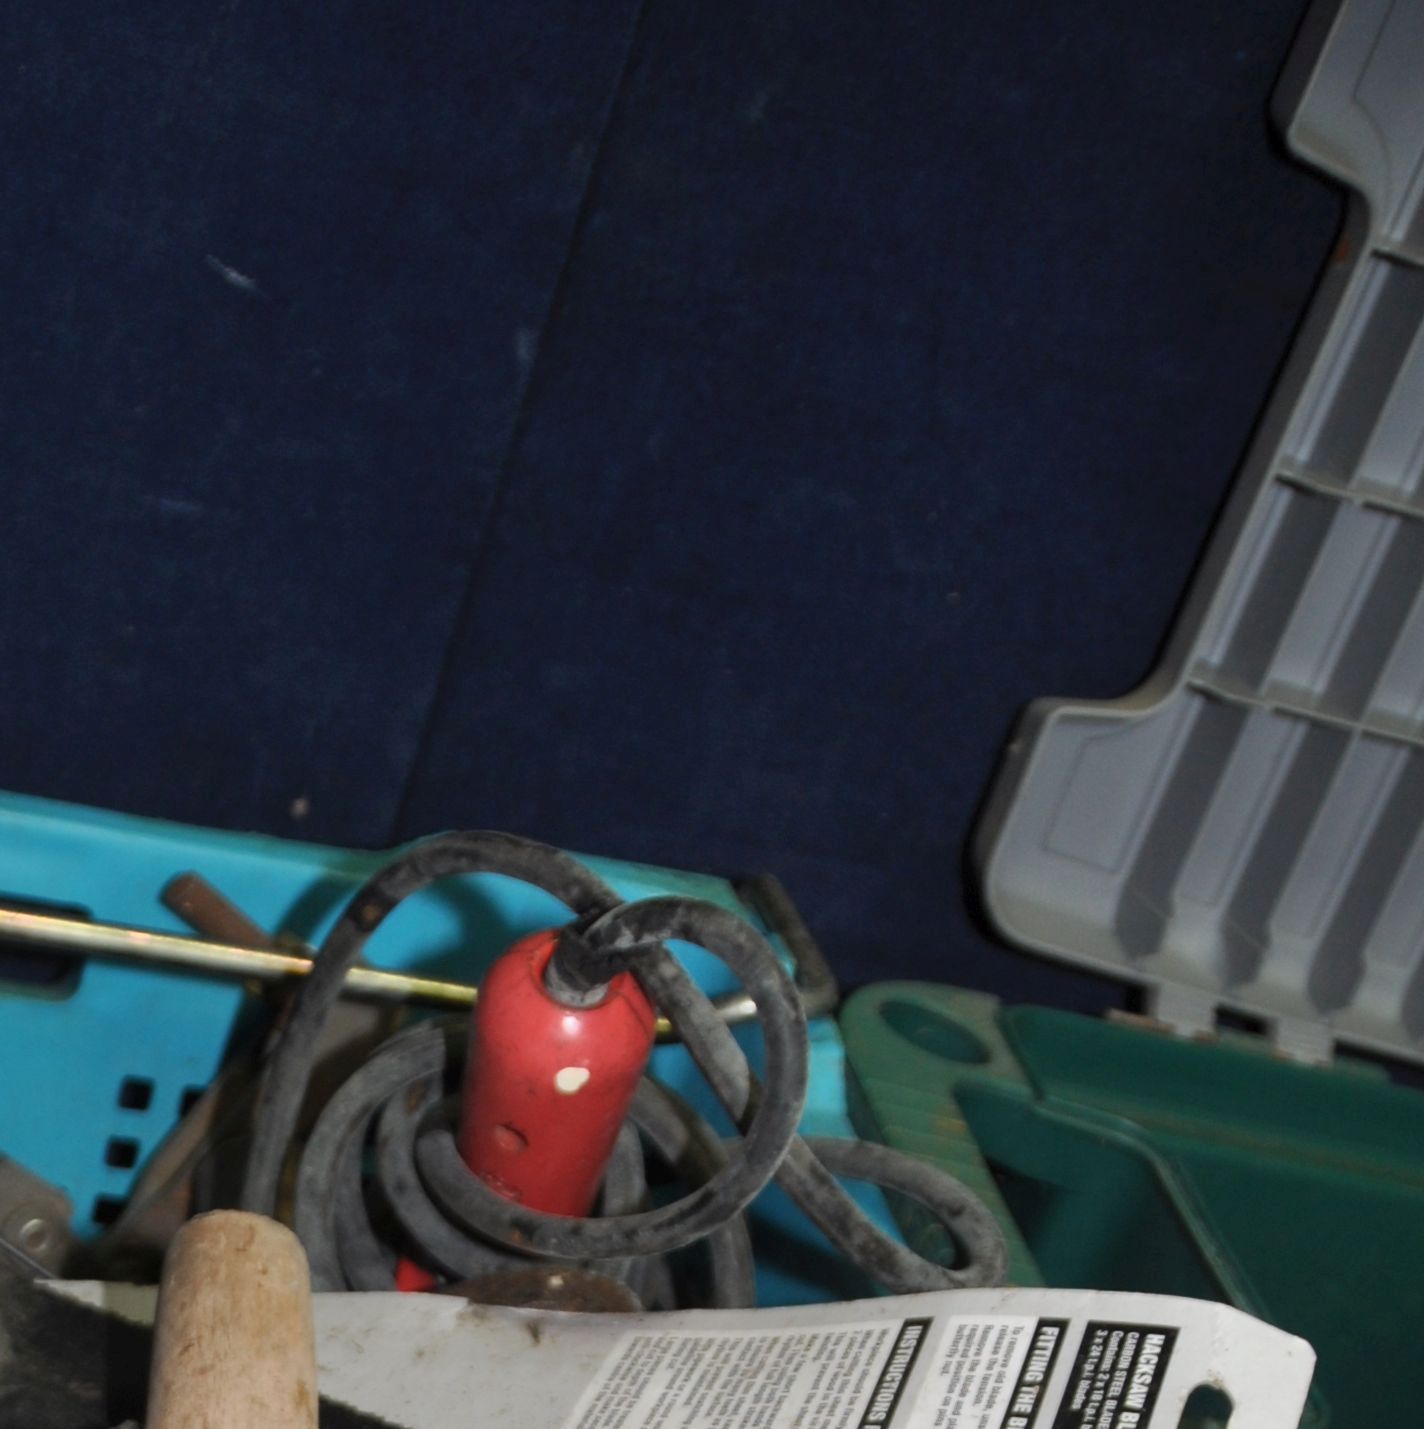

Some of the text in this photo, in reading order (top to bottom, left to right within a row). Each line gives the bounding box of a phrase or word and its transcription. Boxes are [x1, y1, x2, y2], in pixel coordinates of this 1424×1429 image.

[944, 1324, 968, 1358] butterfly
[957, 1324, 980, 1357] required
[972, 1324, 994, 1356] Remove
[989, 1325, 1010, 1355] release
[1011, 1326, 1024, 1335] To
[984, 1358, 998, 1371] the
[999, 1337, 1017, 1367] remove
[1021, 1326, 1061, 1381] FITTING
[1089, 1345, 1103, 1356] 24
[1099, 1330, 1124, 1371] Contains:
[1117, 1331, 1140, 1368] CARBON
[865, 1325, 923, 1423] INSTRUCTIONS
[944, 1360, 967, 1393] position
[966, 1359, 981, 1371] the
[994, 1370, 1007, 1383] old
[1122, 1333, 1166, 1408] HACKSAW
[957, 1374, 975, 1397] blade
[1071, 1379, 1091, 1409] blades
[1107, 1370, 1127, 1396] STEEL
[940, 1396, 952, 1406] on
[950, 1400, 965, 1415] and
[1011, 1385, 1039, 1412] THE
[931, 1408, 948, 1426] pins
